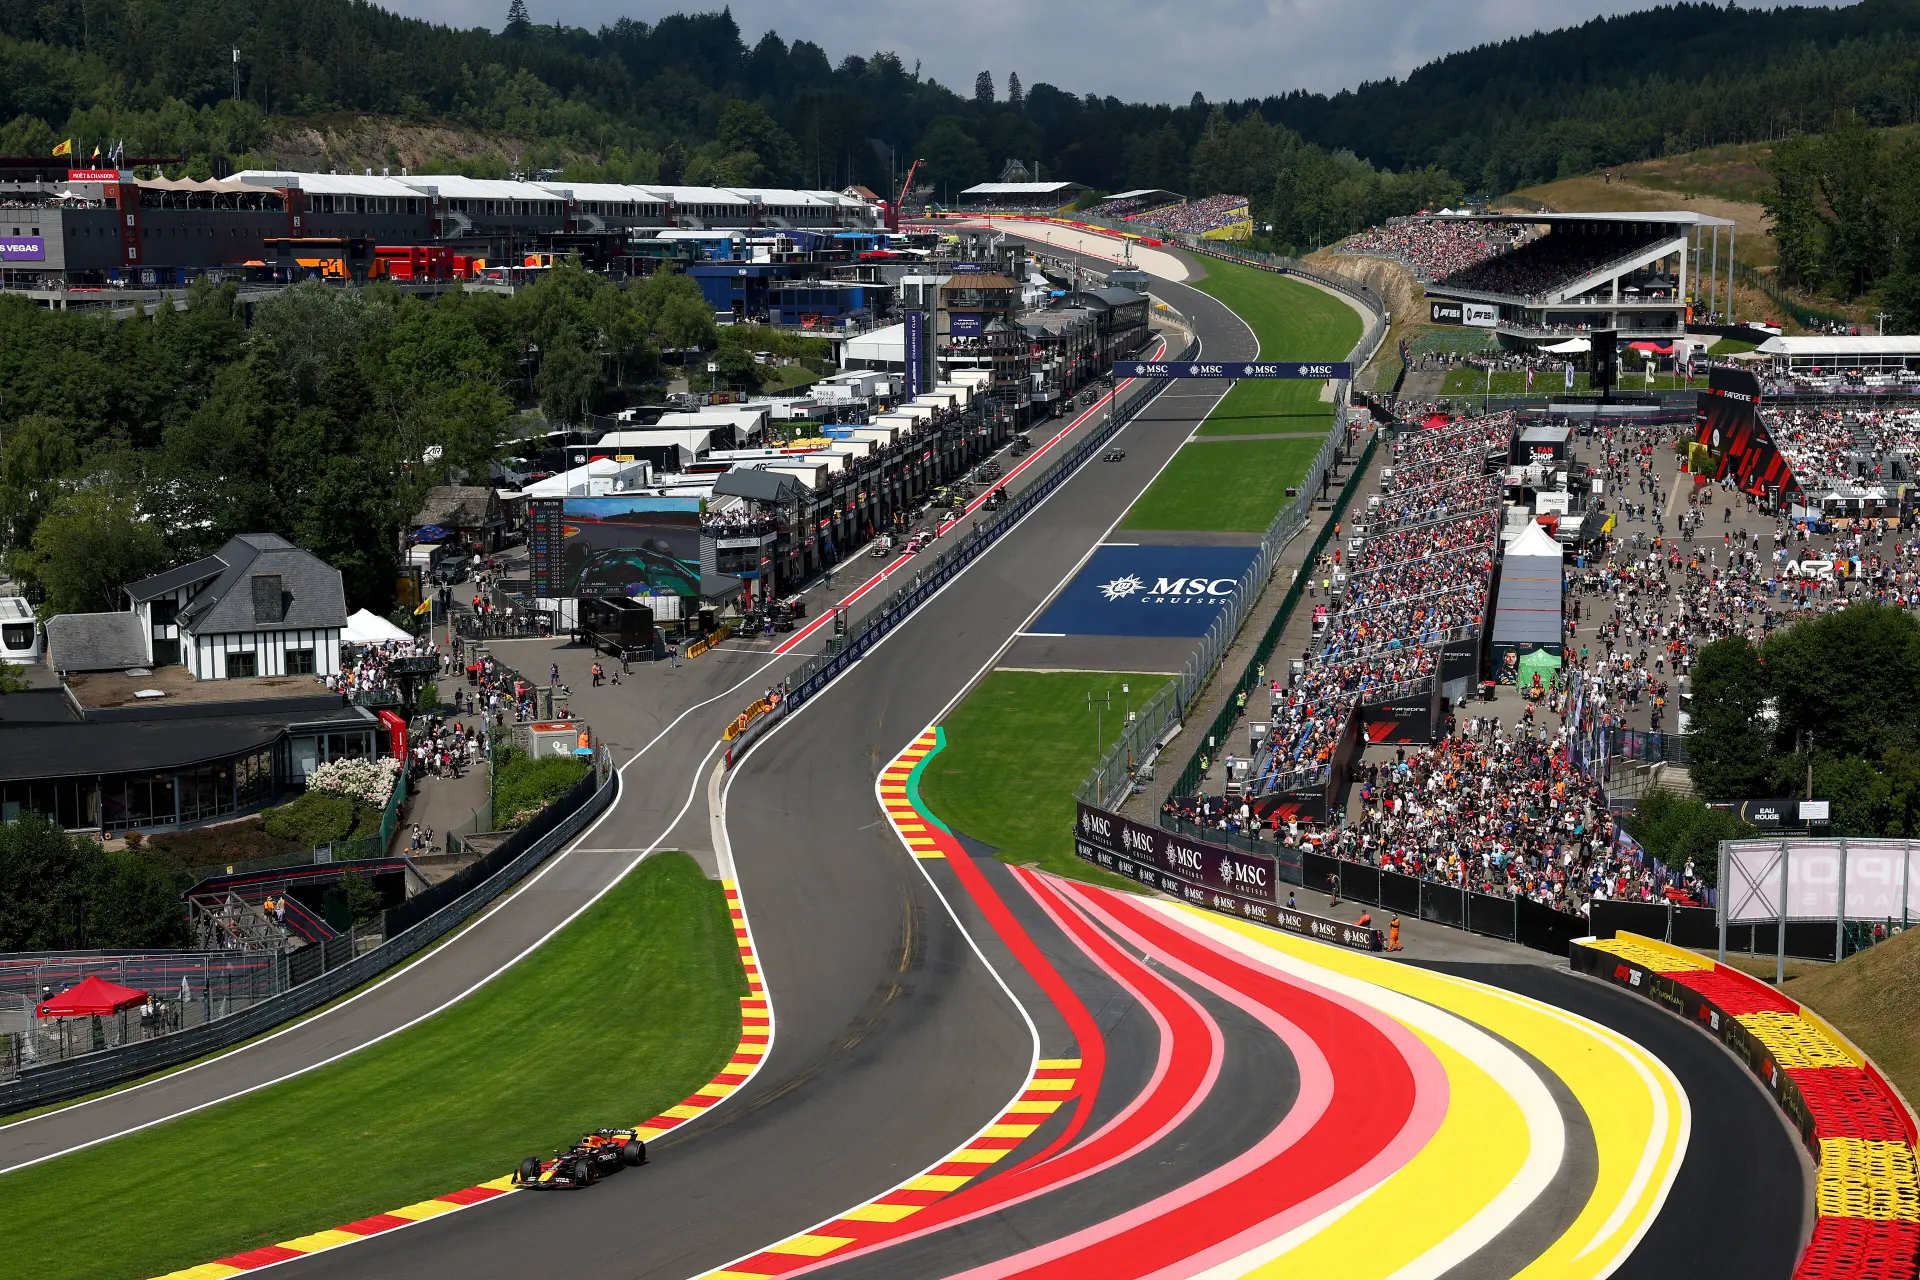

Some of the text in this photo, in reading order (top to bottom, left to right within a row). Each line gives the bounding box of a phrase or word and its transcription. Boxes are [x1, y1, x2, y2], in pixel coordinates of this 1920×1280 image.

[1146, 365, 1168, 373] MSC
[1200, 365, 1222, 373] MSC
[1724, 391, 1751, 402] FANZONE
[1147, 578, 1238, 596] MSC
[1091, 814, 1110, 837] MSC
[1132, 830, 1153, 853] MSC
[1082, 845, 1093, 857] MSC
[1102, 853, 1112, 865] MSC
[1177, 846, 1202, 870] MSC
[1123, 862, 1133, 874] MSC
[1178, 868, 1203, 880] CRUISES
[1235, 862, 1266, 886] MSC
[1144, 870, 1155, 882] MSC
[1167, 879, 1178, 892] MSC
[1235, 884, 1267, 896] CRUISES
[1190, 887, 1204, 900] MSC
[1220, 897, 1235, 909] MSC
[1252, 905, 1267, 918] MSC
[1285, 914, 1301, 927] MSC
[1319, 923, 1336, 936] MSC
[1352, 931, 1370, 944] MSC
[598, 1152, 616, 1162] ORACLE
